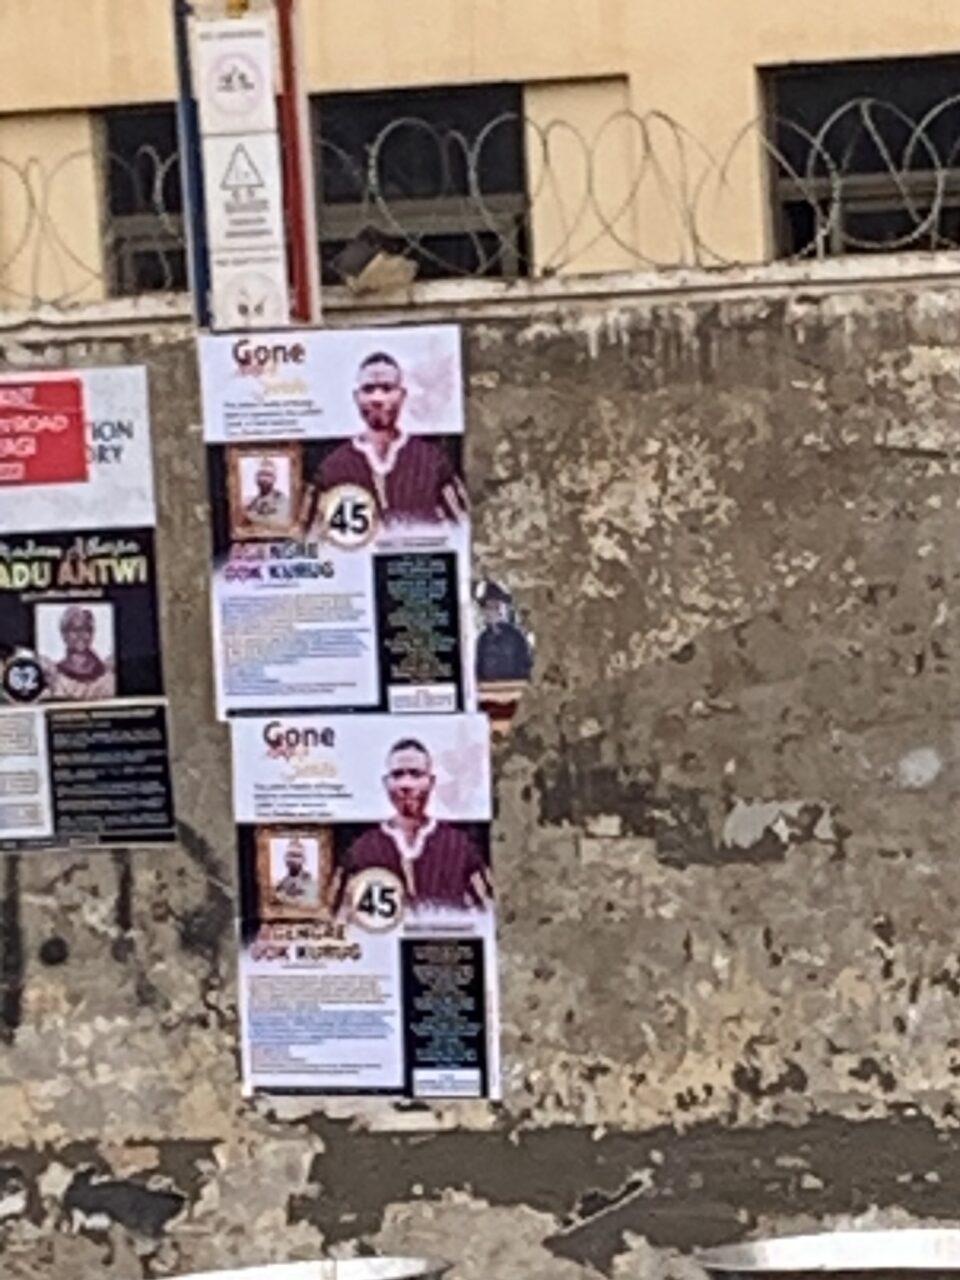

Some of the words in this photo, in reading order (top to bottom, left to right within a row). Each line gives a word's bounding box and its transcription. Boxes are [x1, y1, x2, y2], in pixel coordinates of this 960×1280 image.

[232, 338, 305, 366] Gone
[86, 419, 134, 441] ION
[330, 502, 369, 535] 45
[57, 555, 148, 586] ANTWI
[262, 720, 335, 750] Gone
[357, 885, 398, 919] 45
